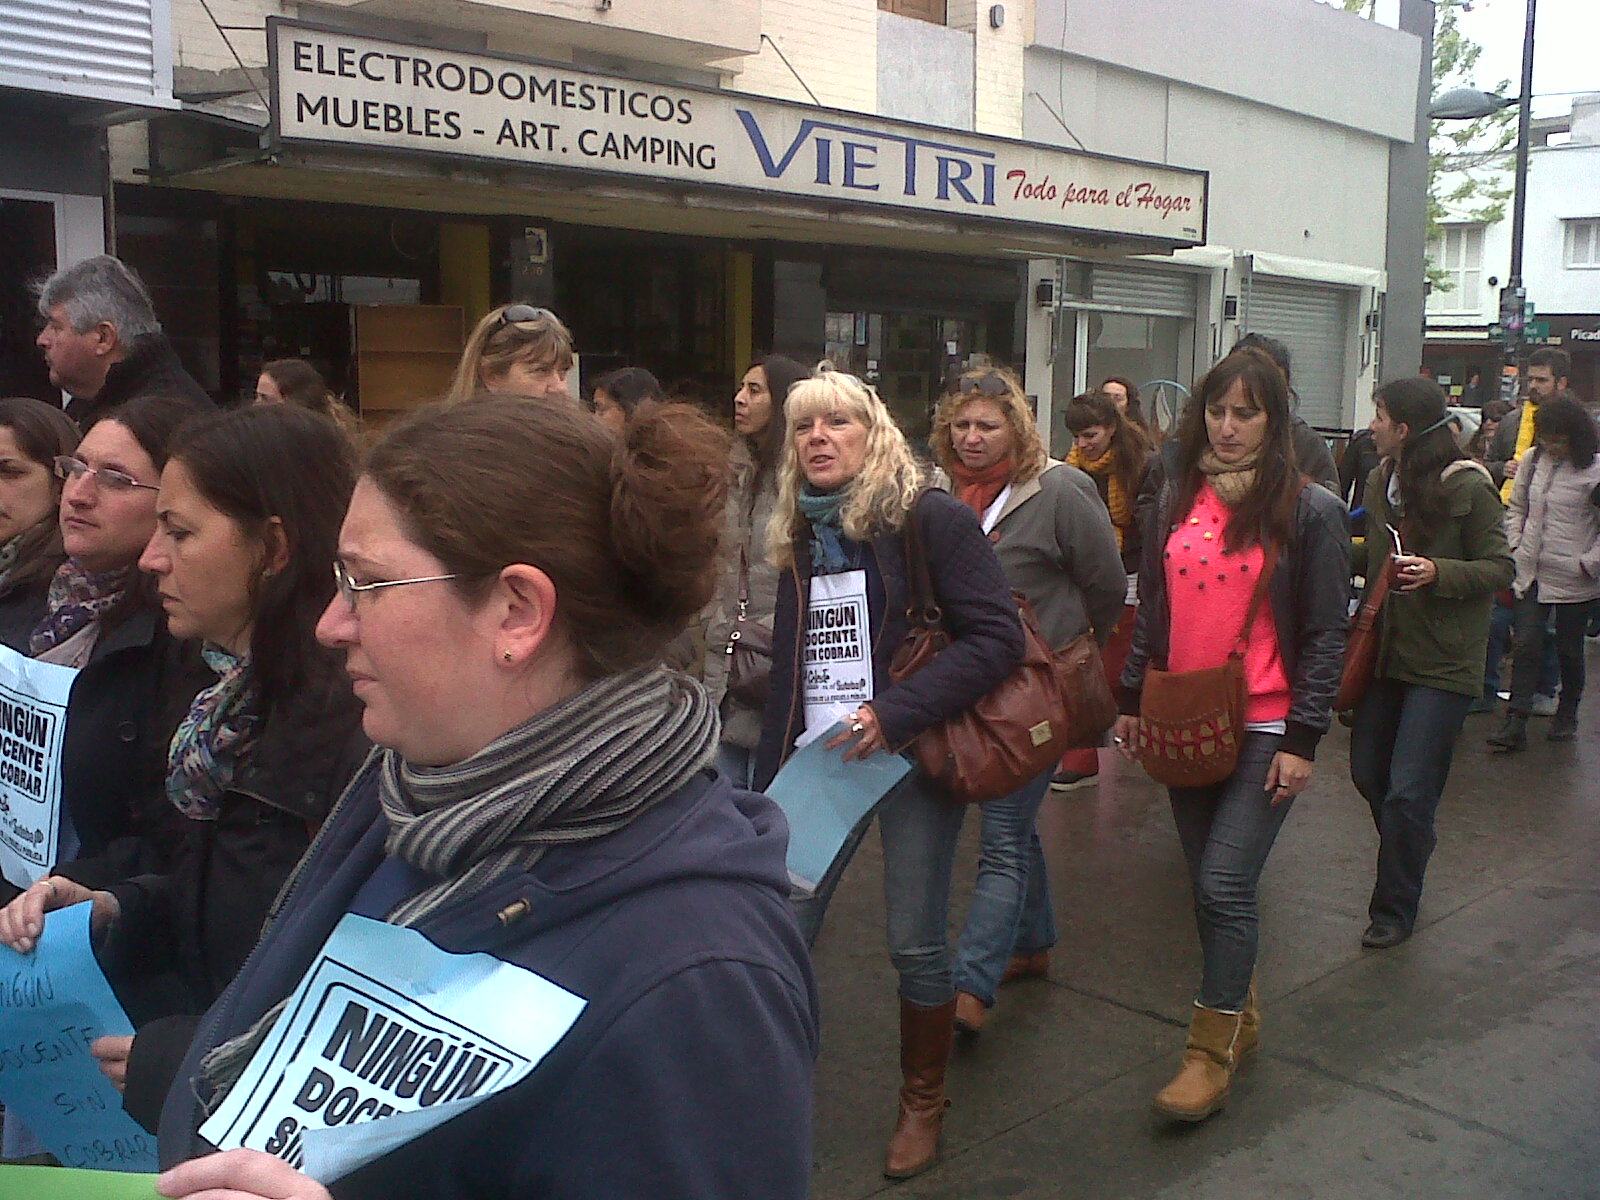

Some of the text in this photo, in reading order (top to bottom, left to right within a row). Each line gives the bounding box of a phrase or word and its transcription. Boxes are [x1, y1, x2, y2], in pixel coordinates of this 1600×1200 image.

[293, 40, 692, 124] ELECTRODOMESTICOS
[296, 93, 461, 140] MUEBLES
[497, 119, 567, 153] ART.
[578, 130, 716, 170] CAMPING
[1006, 170, 1191, 219] Todo para el Hogar
[818, 645, 859, 660] COBRAR
[0, 700, 48, 749] NGÚN
[1, 760, 42, 797] COBRAR
[321, 1000, 500, 1107] NINGÚN
